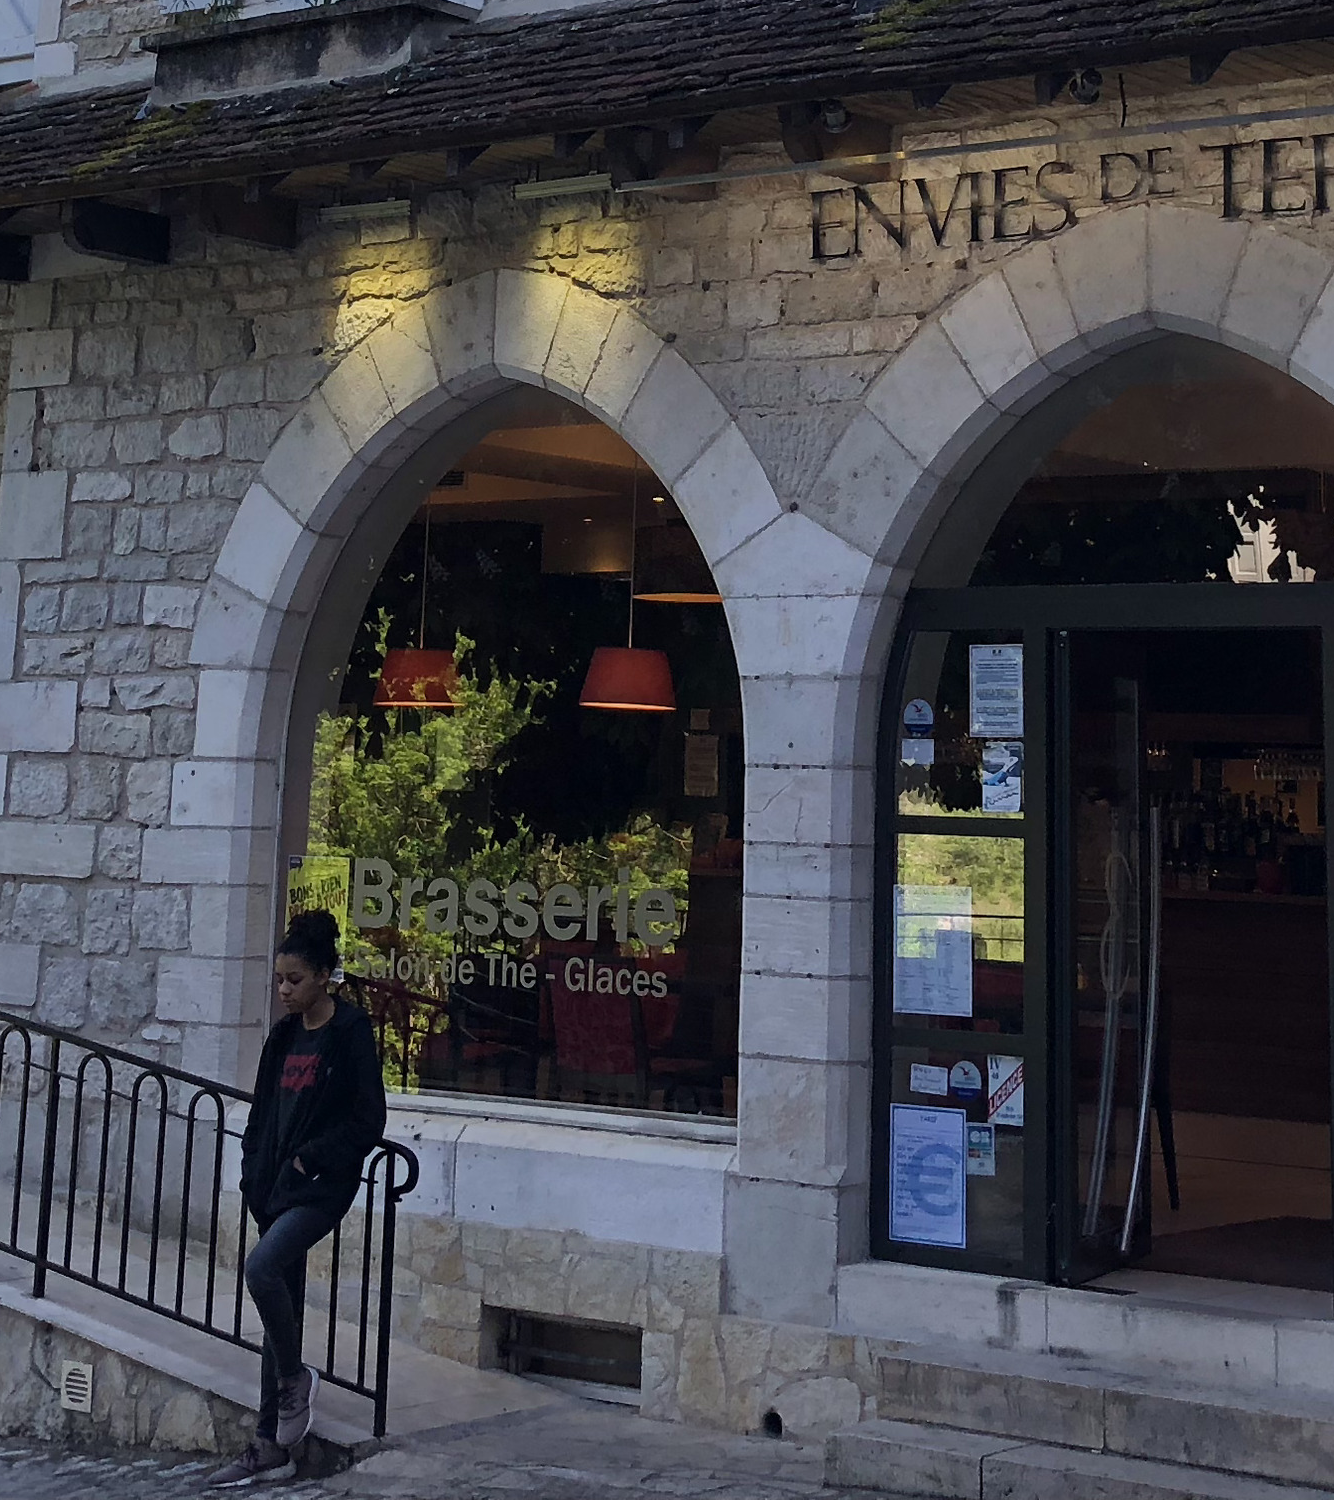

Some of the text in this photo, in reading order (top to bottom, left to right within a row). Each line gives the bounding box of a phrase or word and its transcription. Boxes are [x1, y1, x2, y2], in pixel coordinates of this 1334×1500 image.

[808, 160, 1079, 260] ENVIES
[1100, 146, 1176, 205] DE
[352, 856, 677, 946] Brasserie
[354, 946, 430, 983] Salon
[440, 949, 476, 986] de
[484, 952, 537, 988] Thé
[564, 956, 668, 998] Glaces
[989, 1064, 1024, 1114] LICENCE
